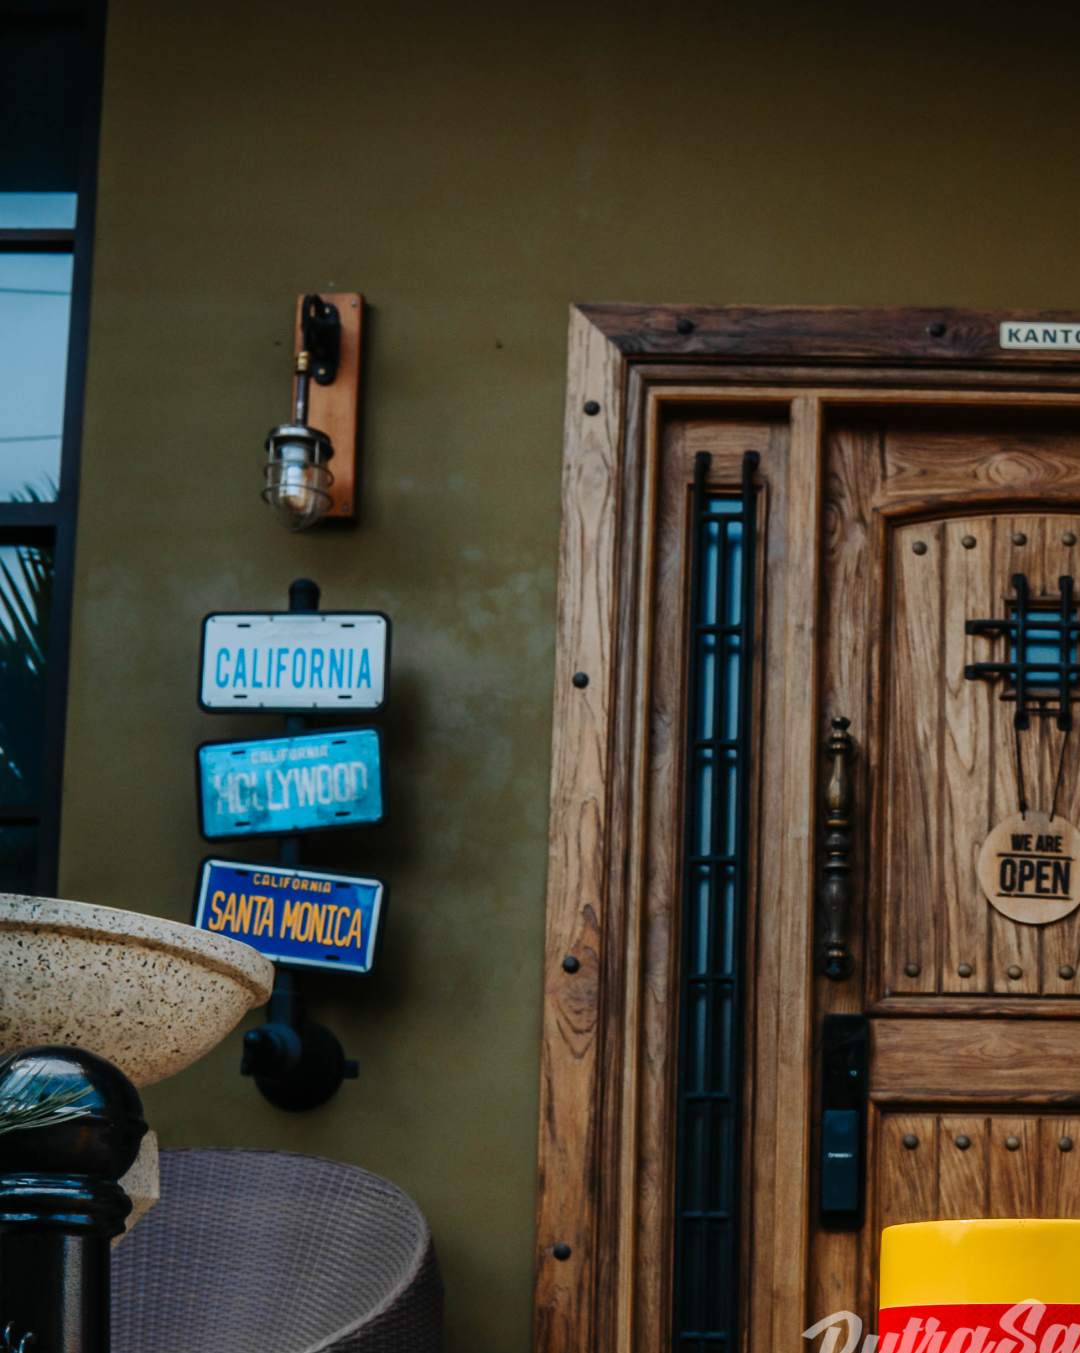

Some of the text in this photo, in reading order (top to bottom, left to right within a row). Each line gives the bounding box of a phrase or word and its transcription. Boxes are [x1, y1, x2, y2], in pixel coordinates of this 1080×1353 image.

[215, 647, 372, 689] CALIFORNIA
[250, 745, 329, 765] CALIFORNIA
[214, 761, 368, 815] HOLLYWOOD
[1011, 833, 1063, 853] WE ARE
[253, 873, 332, 894] CALIFORNIA
[1000, 858, 1071, 895] OPEN
[208, 890, 362, 949] SANTA MONICA
